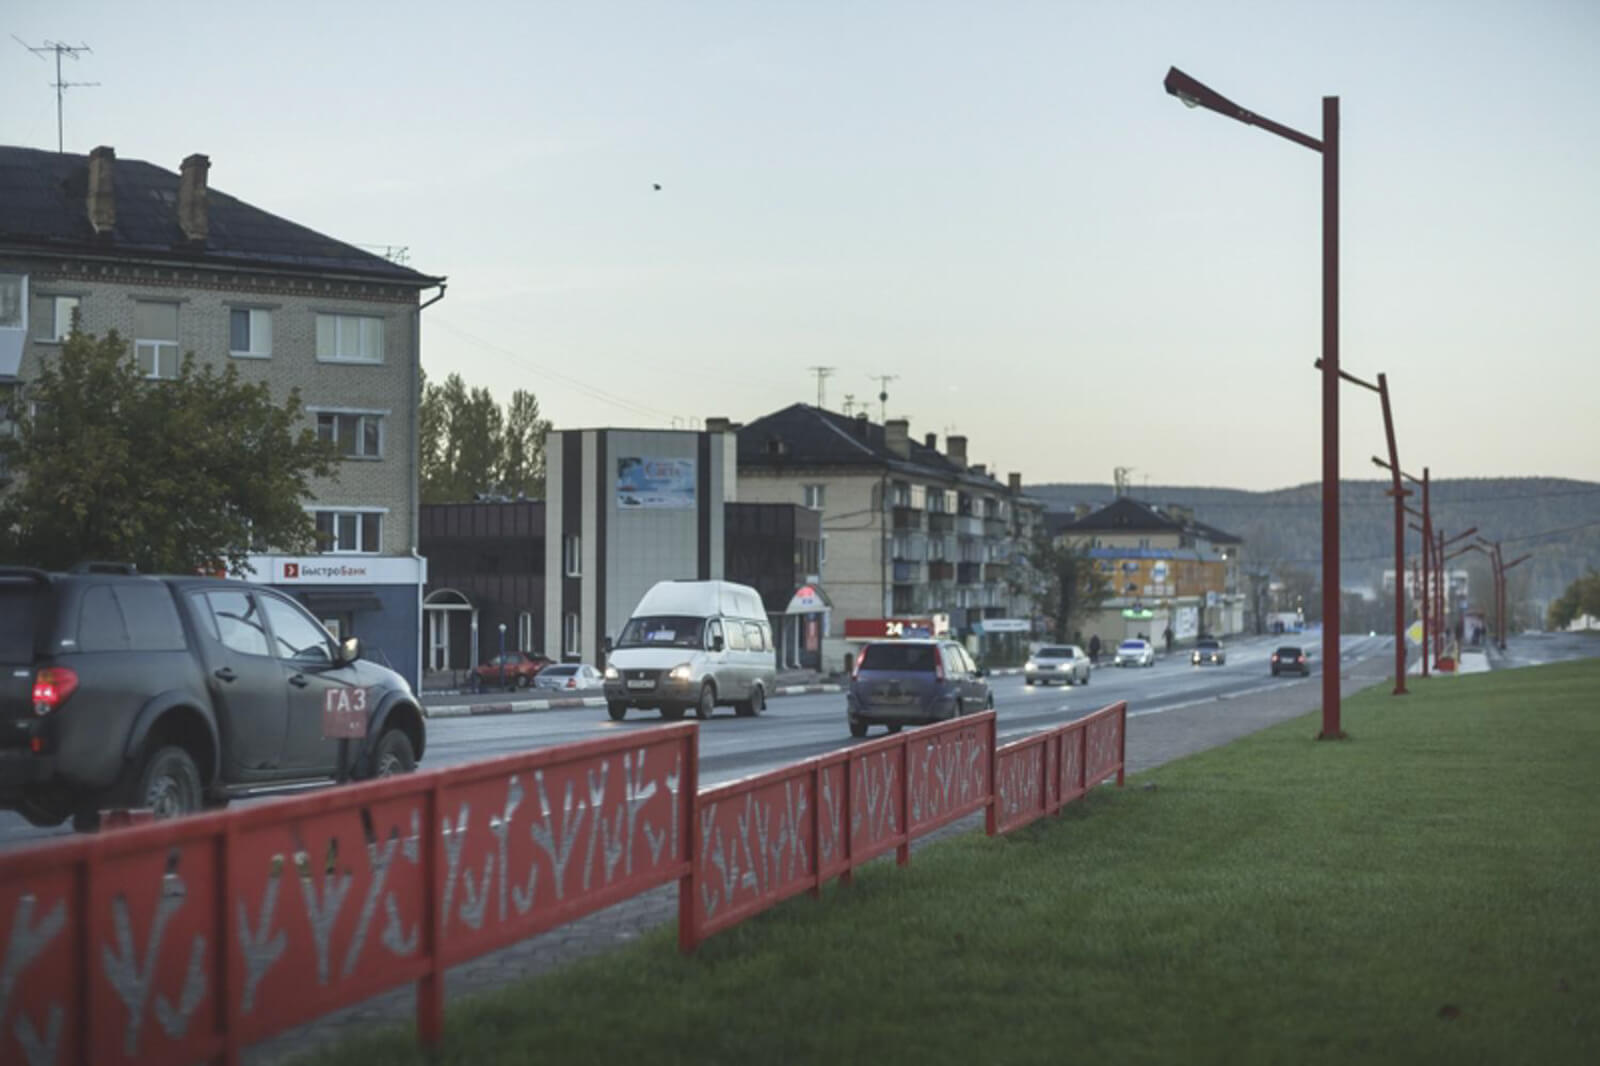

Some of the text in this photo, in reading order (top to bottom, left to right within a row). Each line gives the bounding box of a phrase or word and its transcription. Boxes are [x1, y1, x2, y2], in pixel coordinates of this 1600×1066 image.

[301, 565, 367, 578] БыстроБанк
[885, 621, 904, 636] 24
[326, 688, 367, 712] ГАЗ
